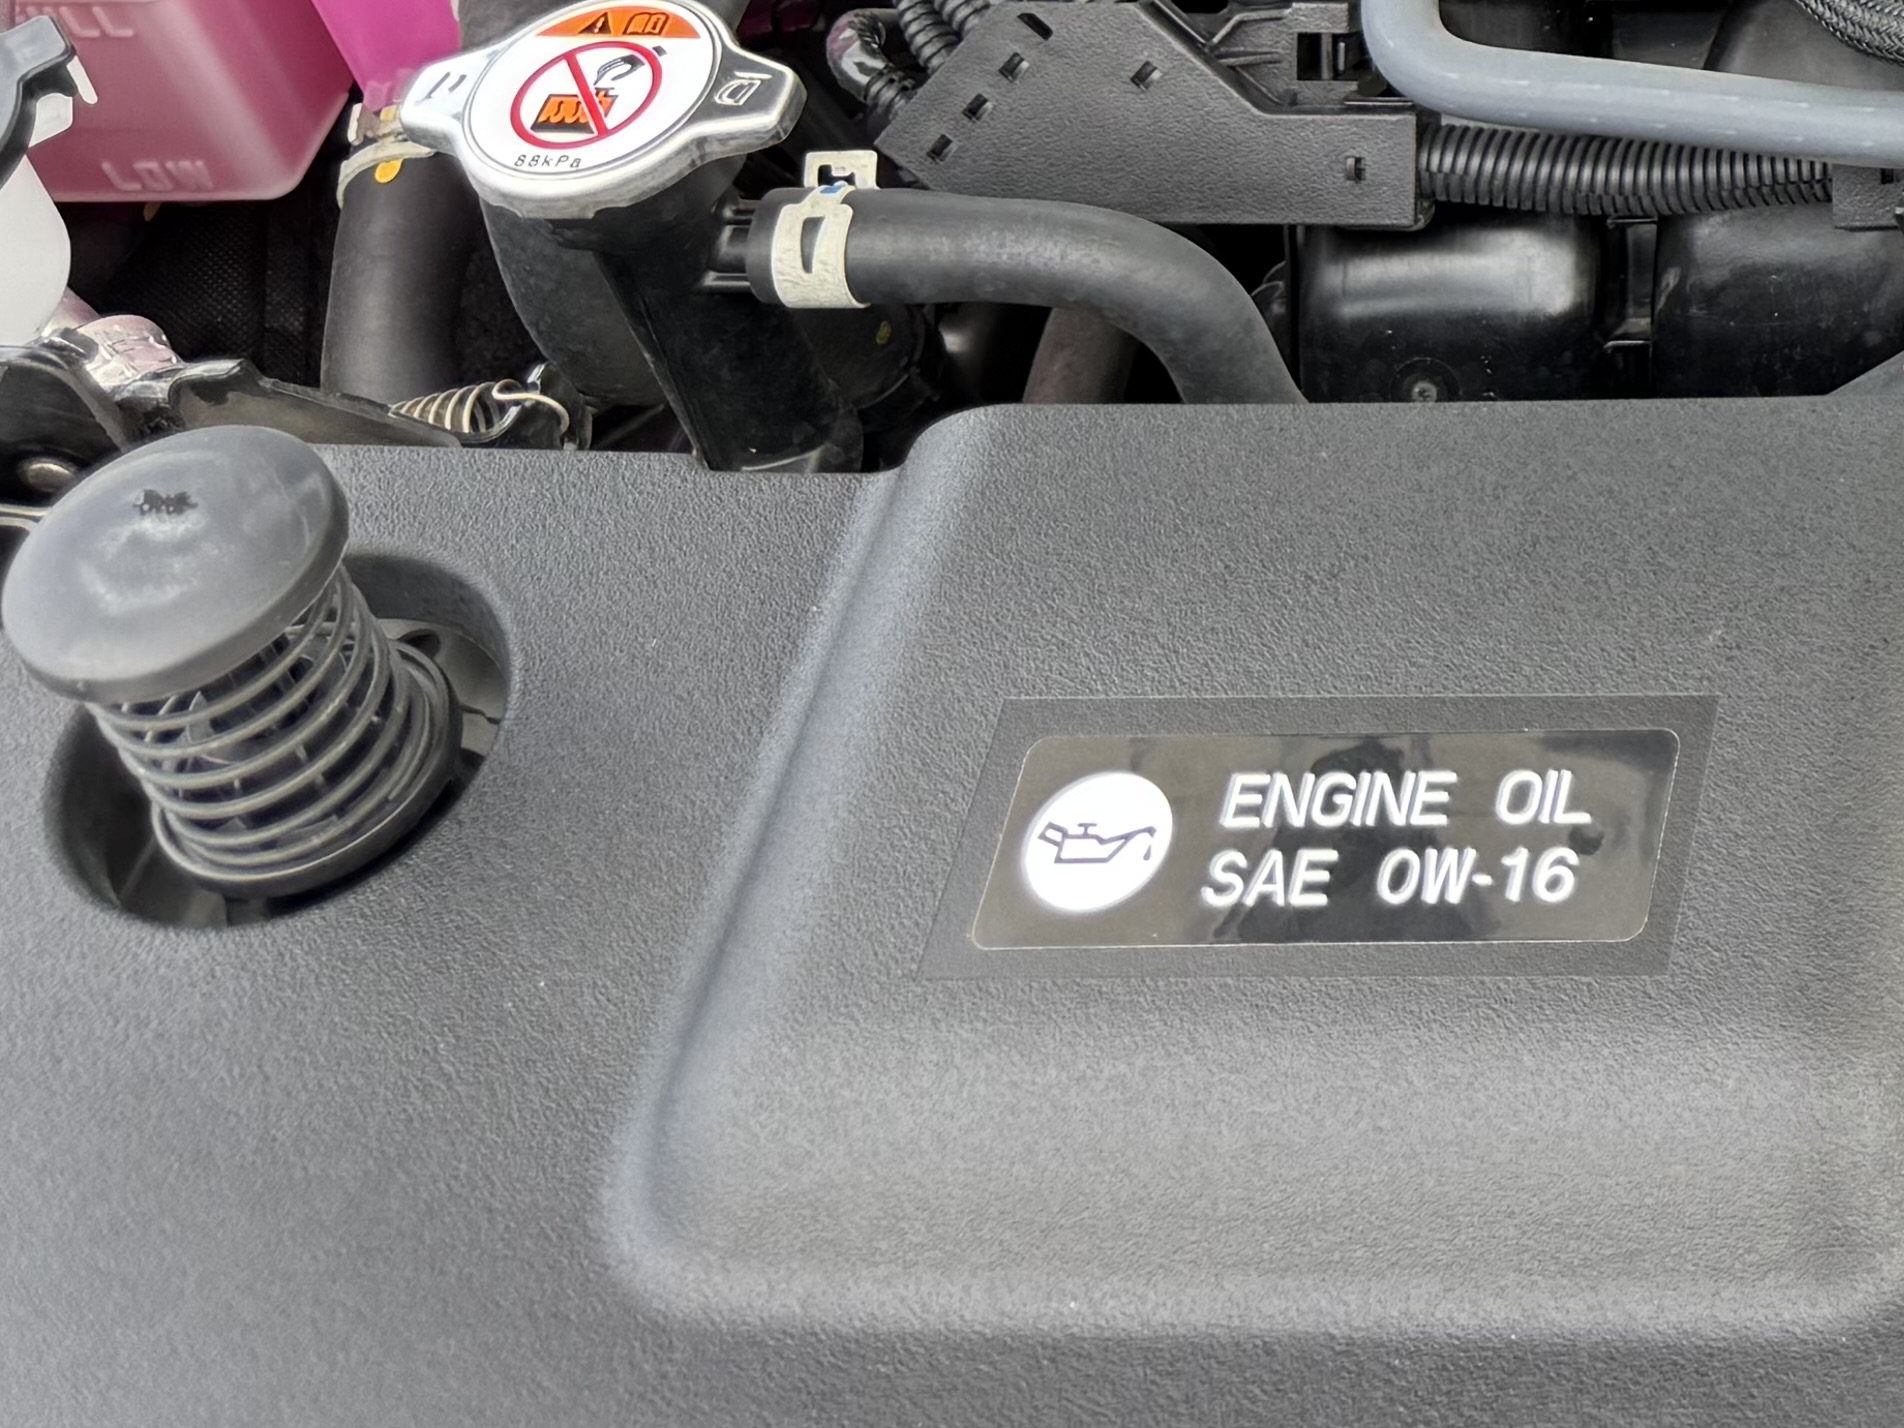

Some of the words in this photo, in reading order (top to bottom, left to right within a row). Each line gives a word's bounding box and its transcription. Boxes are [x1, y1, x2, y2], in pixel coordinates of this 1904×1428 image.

[101, 160, 214, 191] LOW
[513, 153, 582, 169] 88kPa
[1218, 769, 1458, 830] ENGINE
[1493, 768, 1593, 827] OIL
[1200, 847, 1339, 909] SAE
[1376, 845, 1581, 907] 0W-16
